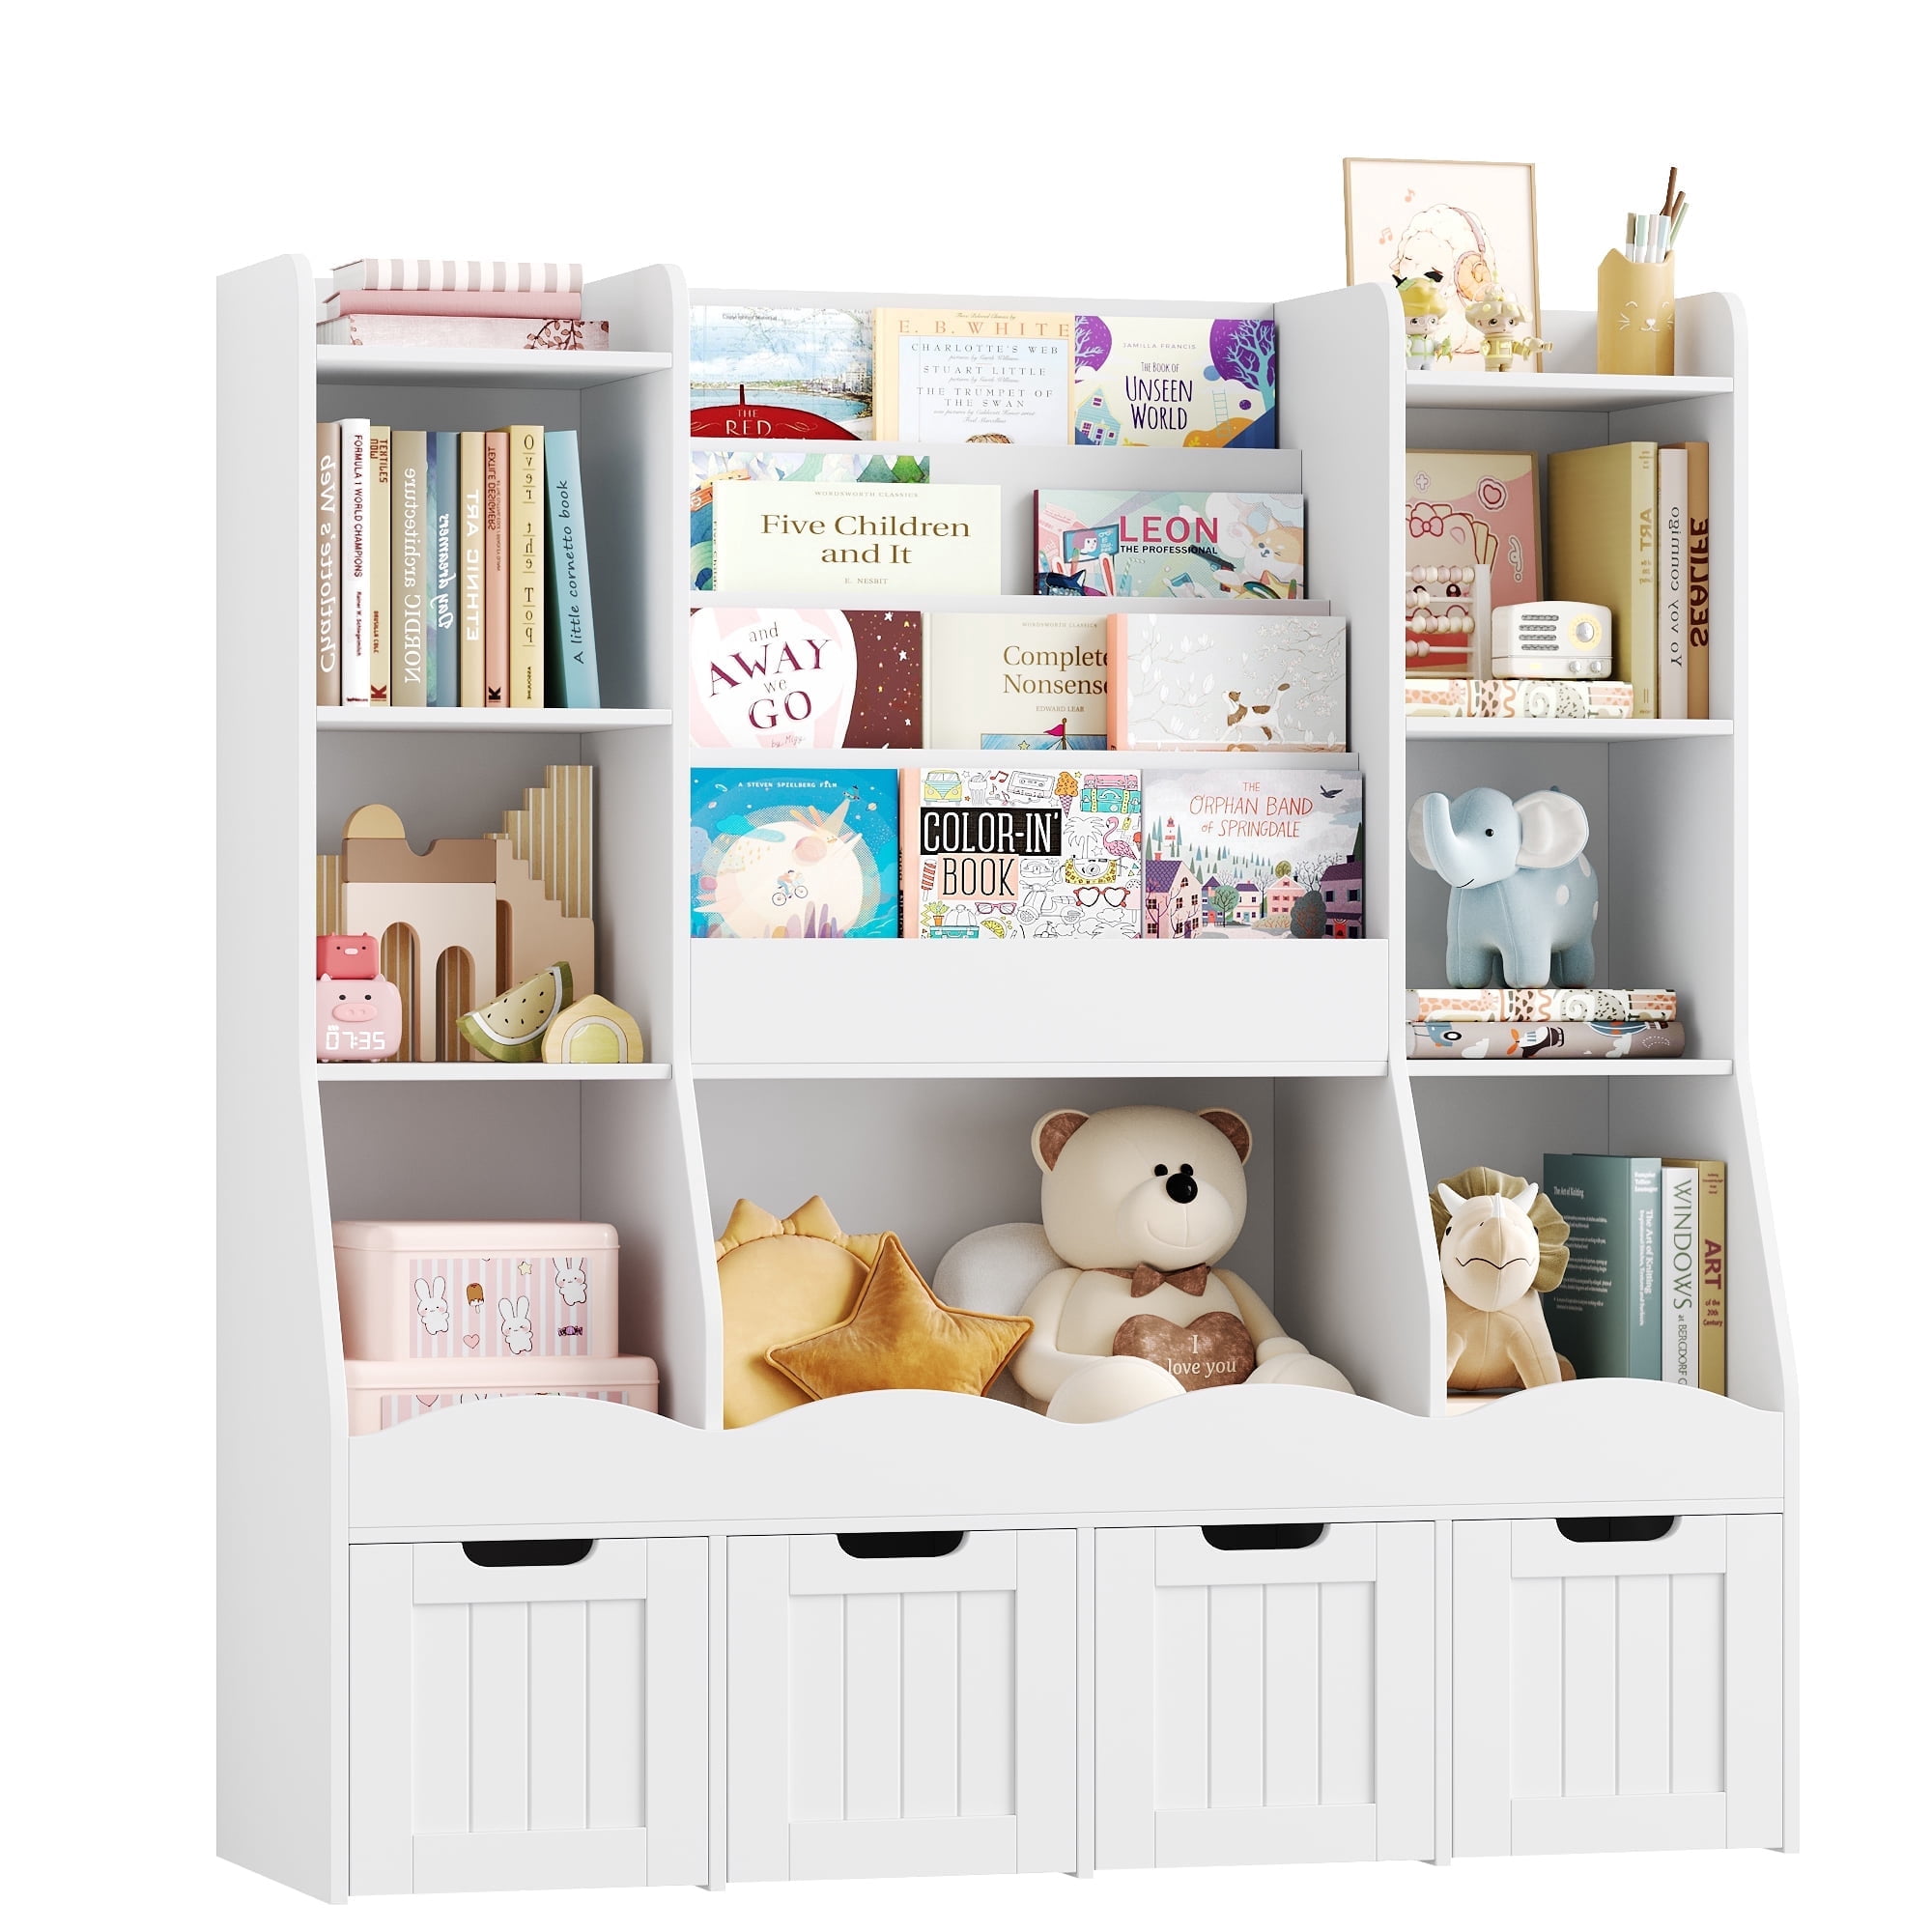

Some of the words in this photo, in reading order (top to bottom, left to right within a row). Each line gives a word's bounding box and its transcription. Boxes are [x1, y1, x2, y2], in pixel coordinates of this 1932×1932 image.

[899, 320, 919, 334] E.
[935, 321, 954, 334] B.
[968, 322, 1069, 337] WHITE
[912, 343, 1019, 354] CHARLOTTE'S
[1029, 346, 1059, 355] WEB
[923, 366, 983, 375] STUART
[992, 366, 1046, 377] LITTLE
[1141, 361, 1151, 372] THE
[1152, 362, 1170, 373] BOOK
[1171, 363, 1179, 373] OF
[917, 386, 946, 395] THE
[953, 387, 1026, 397] TRUMPET
[1035, 389, 1054, 398] OF
[1125, 375, 1193, 403] UNSEEN
[944, 398, 974, 407] THE
[982, 399, 1025, 408] SWAN
[737, 410, 758, 418] THE
[1130, 403, 1187, 431] WORLD
[725, 419, 772, 436] RED
[355, 435, 363, 478] FORMULA
[379, 439, 388, 483] TEXTILES
[355, 488, 363, 522] WORLD
[556, 480, 570, 518] book
[760, 514, 826, 535] Five
[834, 516, 971, 537] Children
[1120, 516, 1218, 544] LEON
[355, 524, 363, 578] CHAMPIONS
[820, 544, 881, 564] and
[888, 545, 912, 564] It
[1121, 545, 1139, 554] THE
[1142, 545, 1218, 554] PROFESSIONAL
[563, 526, 578, 597] cornetto
[568, 606, 582, 644] little
[749, 621, 779, 642] and
[574, 651, 584, 664] A
[708, 639, 833, 697] AWAY
[763, 678, 788, 694] we
[748, 691, 812, 729] GO
[1242, 781, 1261, 792] THE
[1265, 796, 1314, 815] BAND
[1201, 821, 1214, 834] of
[1217, 819, 1301, 838] SPRINGDALE
[942, 858, 1015, 896] BOOK
[326, 1031, 385, 1050] 07:35
[1645, 1208, 1654, 1227] The
[1646, 1245, 1654, 1256] of
[1673, 1179, 1692, 1309] WINDOWS
[1705, 1238, 1722, 1290] ART
[1644, 1257, 1654, 1294] Knitting
[1705, 1298, 1711, 1307] of
[1712, 1298, 1720, 1307] the
[1703, 1319, 1723, 1327] Century
[1192, 1334, 1199, 1354] I
[1678, 1324, 1687, 1376] BERGDORF
[1168, 1358, 1201, 1376] love
[1205, 1360, 1237, 1378] you
